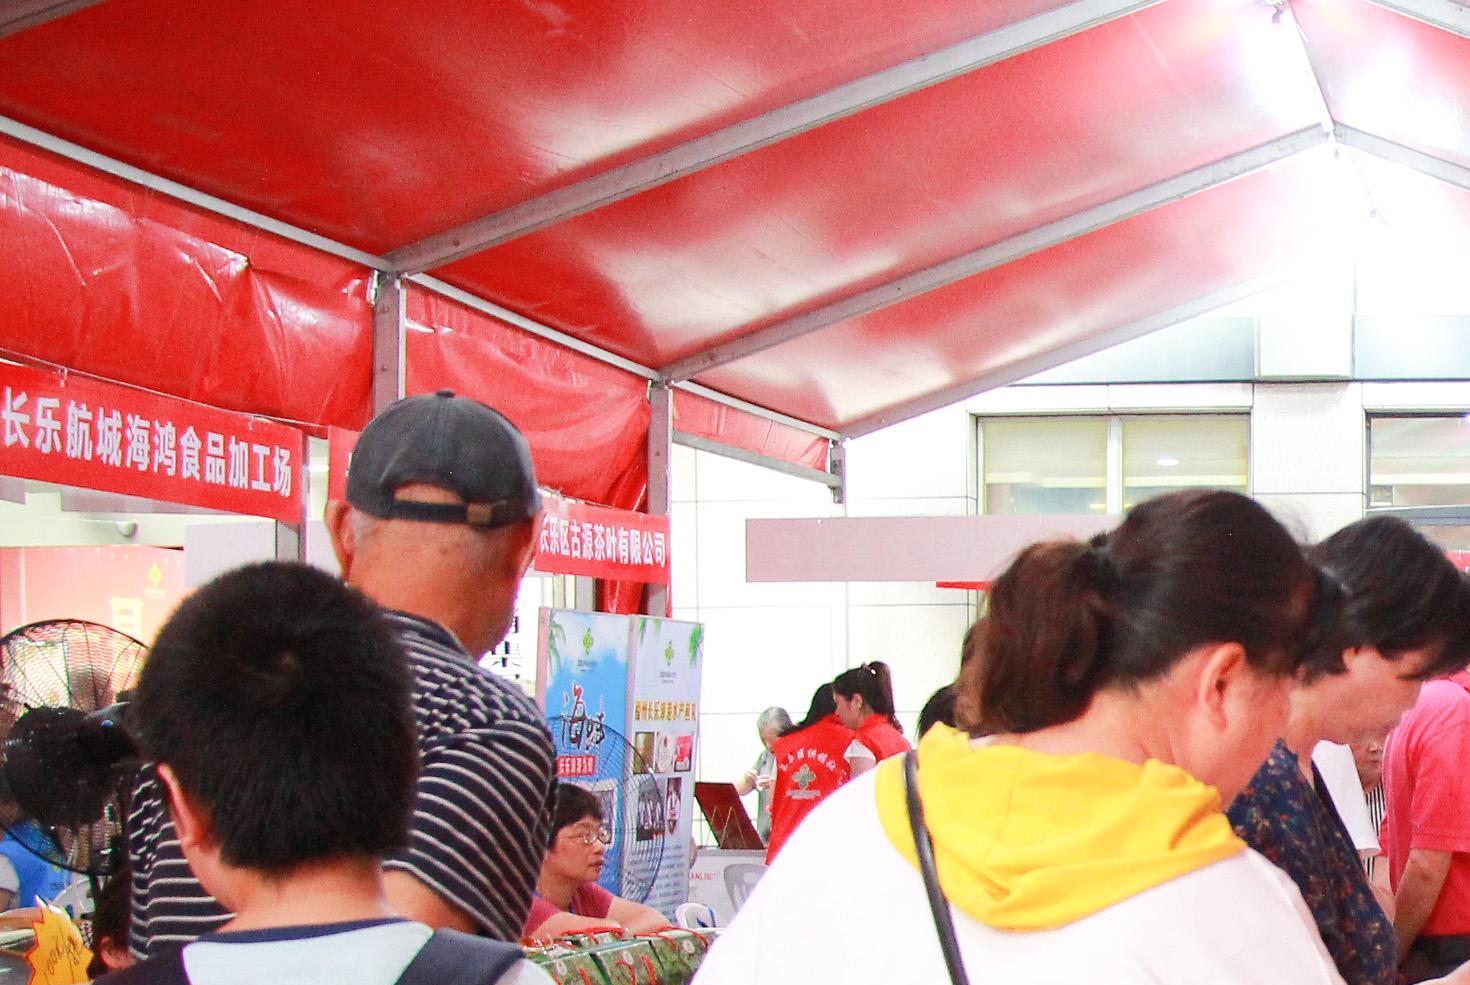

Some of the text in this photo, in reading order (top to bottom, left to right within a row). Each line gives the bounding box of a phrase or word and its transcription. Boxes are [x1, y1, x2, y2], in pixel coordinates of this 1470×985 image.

[2, 387, 292, 498] 长乐航城海鸿食品加工场
